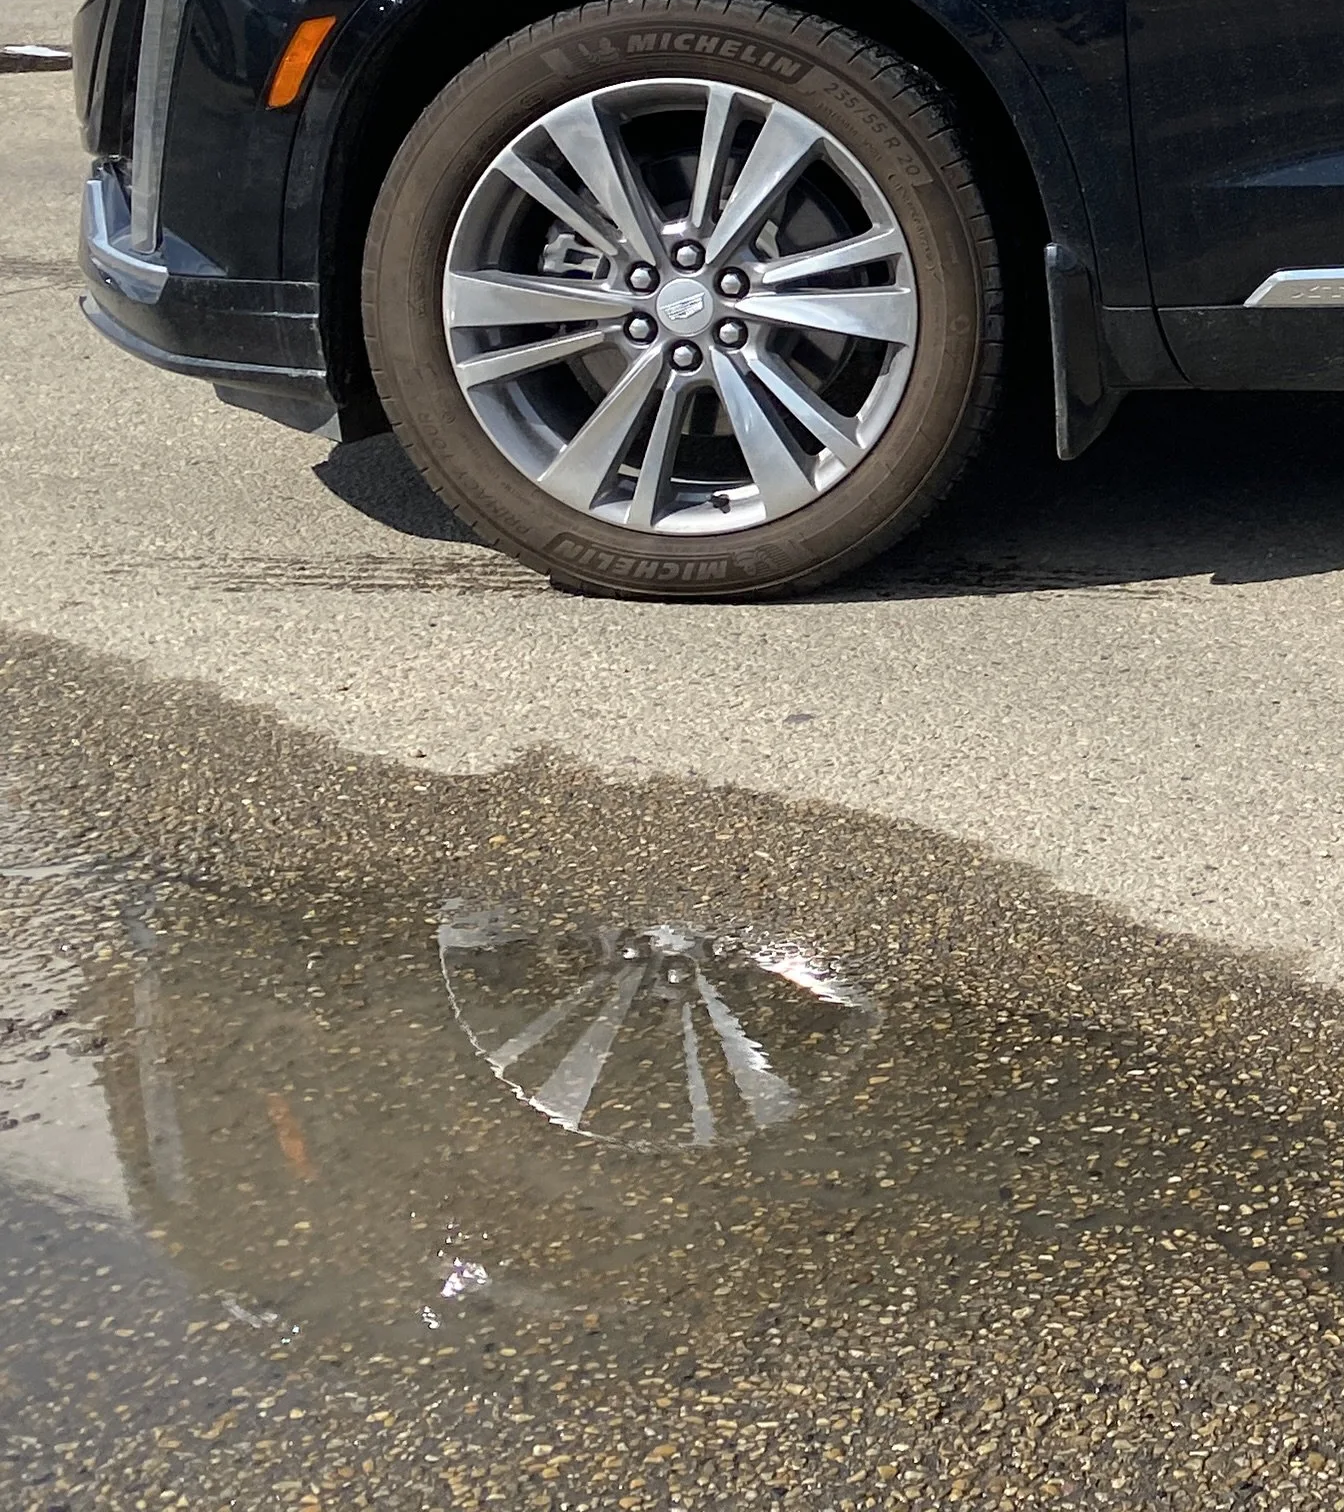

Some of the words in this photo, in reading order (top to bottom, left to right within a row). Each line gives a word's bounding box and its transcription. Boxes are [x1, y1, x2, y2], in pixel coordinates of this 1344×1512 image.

[627, 32, 801, 78] MICHELIN
[824, 82, 888, 134] 235/55
[553, 540, 727, 582] MICHELIN
